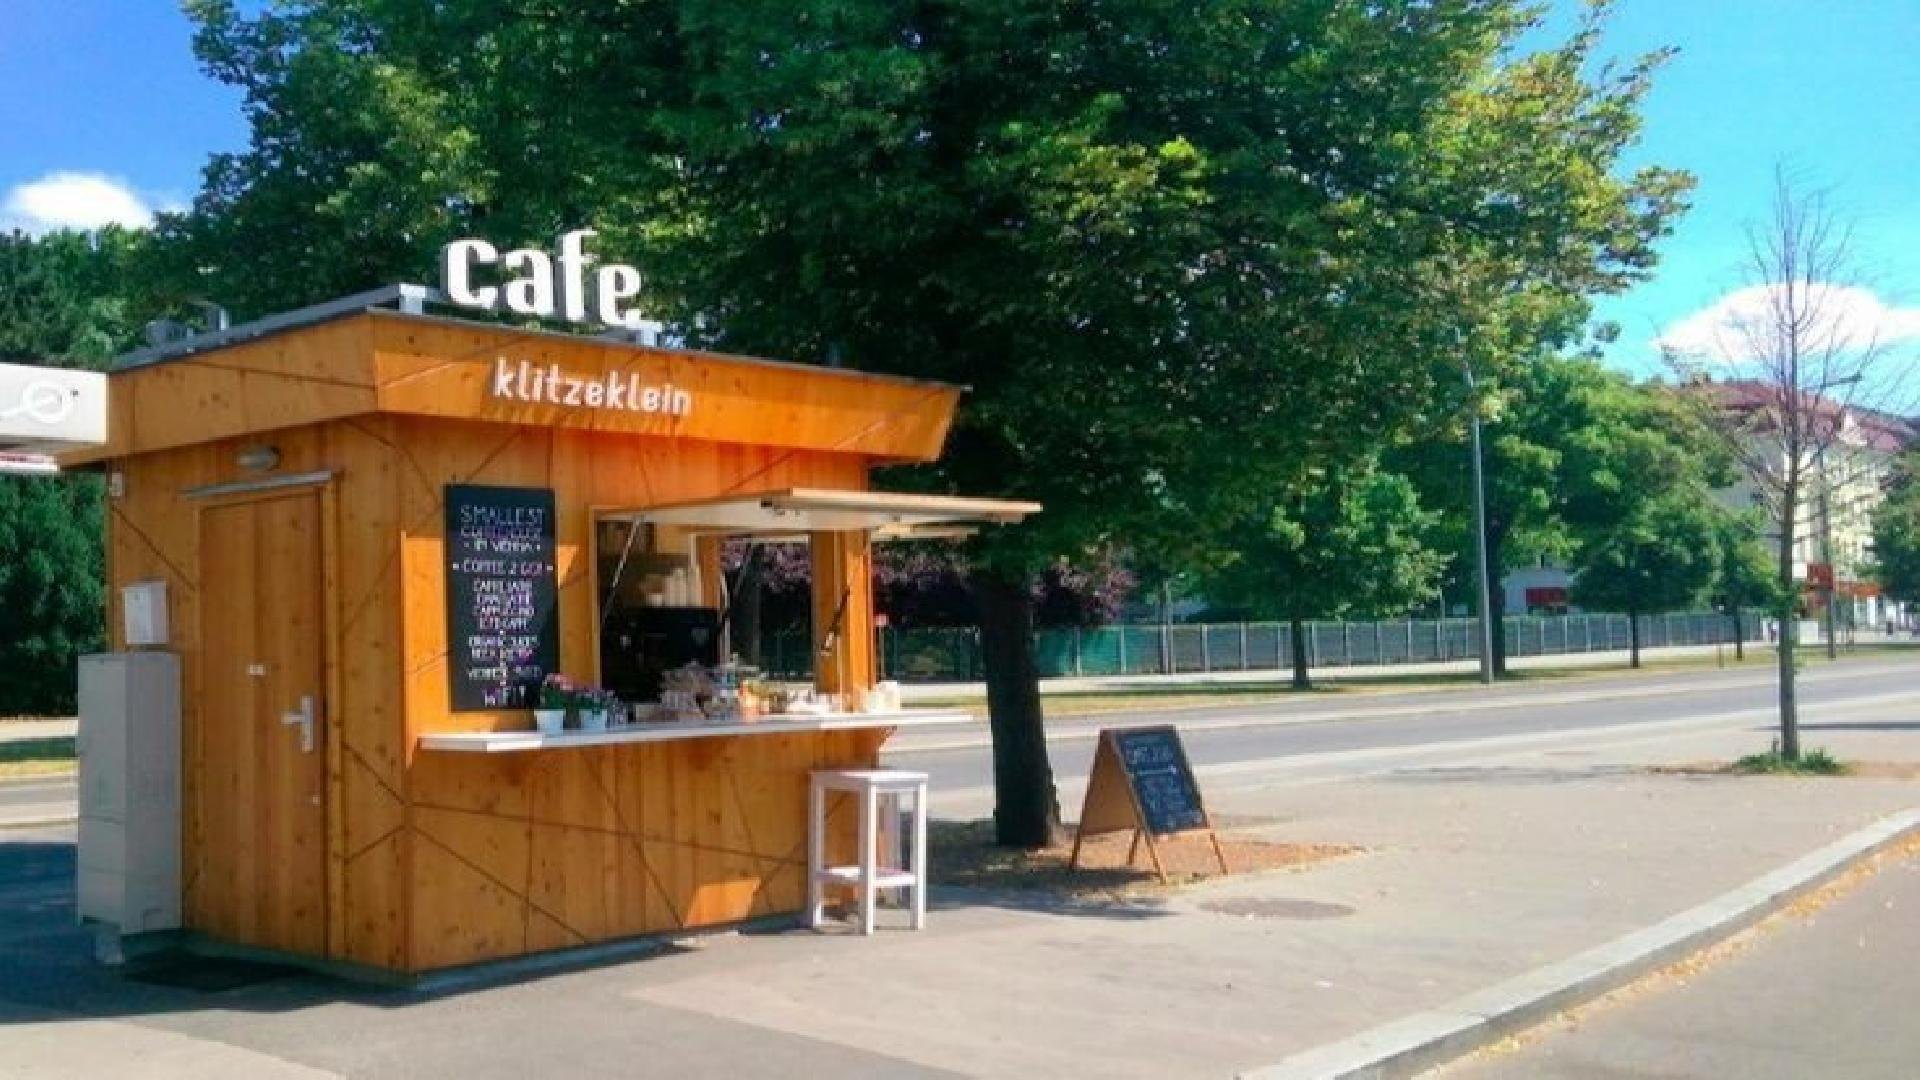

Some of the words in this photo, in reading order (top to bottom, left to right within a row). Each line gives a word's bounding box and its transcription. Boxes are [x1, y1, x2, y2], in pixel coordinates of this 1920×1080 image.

[441, 227, 642, 326] cafe
[494, 356, 692, 414] klitzeklein
[460, 505, 543, 526] SMALLEST
[463, 557, 504, 575] COFFEE
